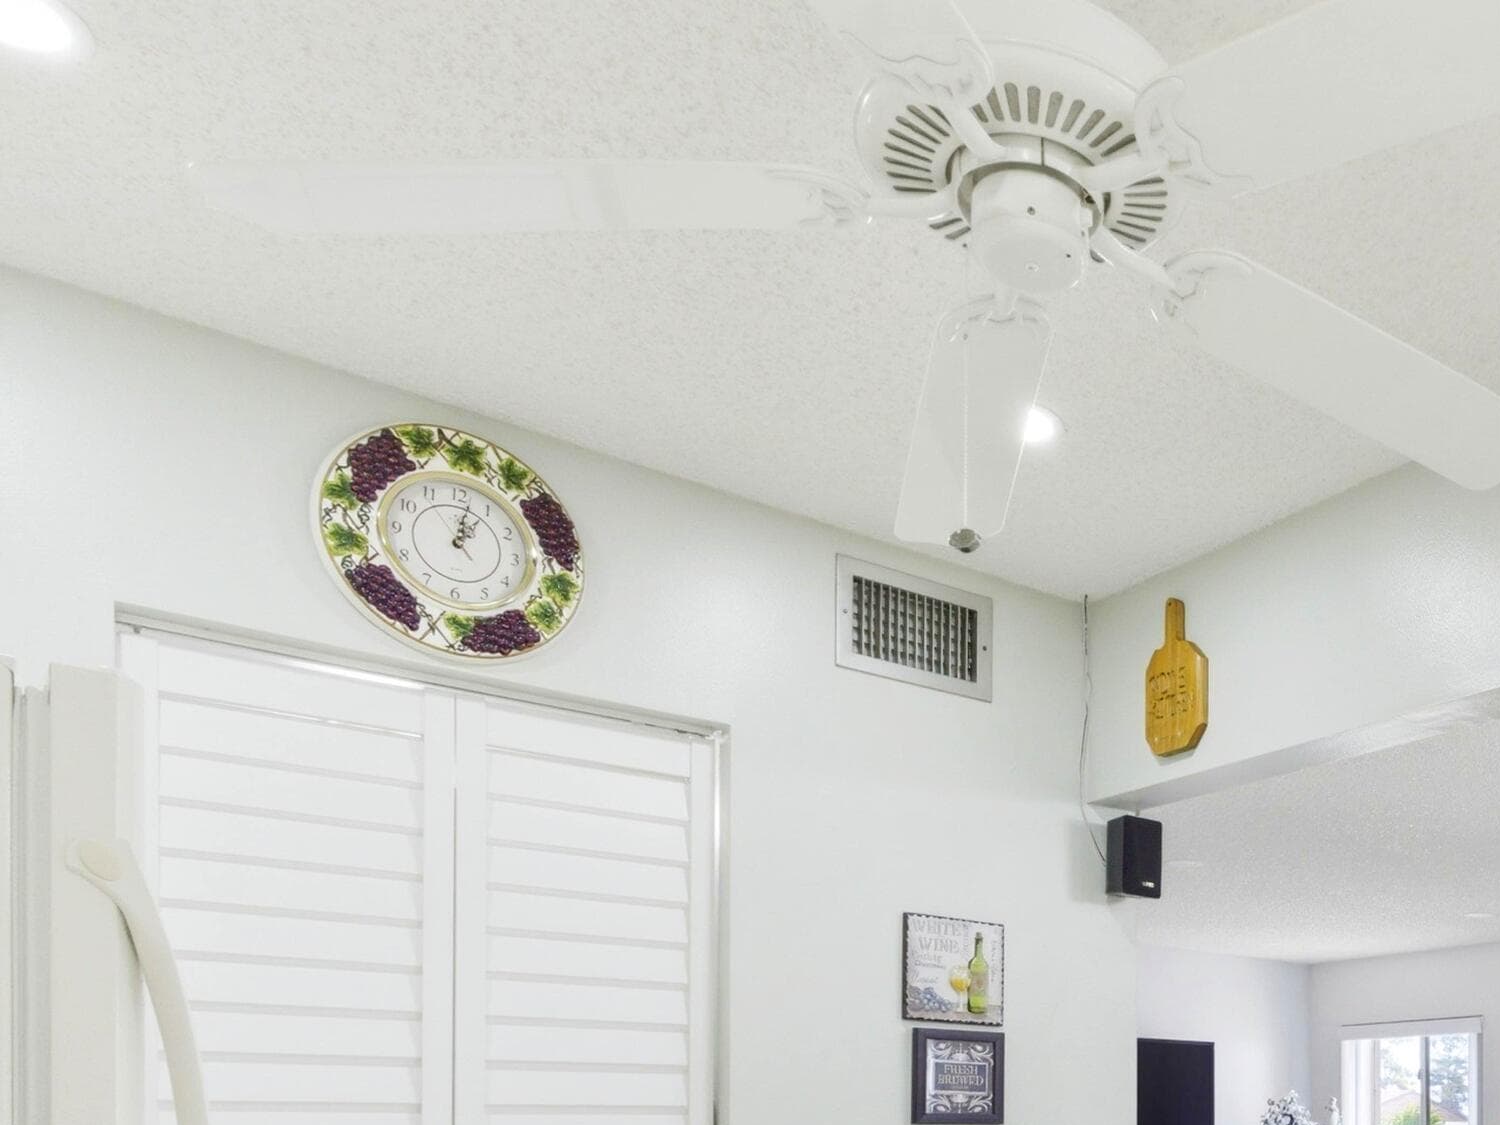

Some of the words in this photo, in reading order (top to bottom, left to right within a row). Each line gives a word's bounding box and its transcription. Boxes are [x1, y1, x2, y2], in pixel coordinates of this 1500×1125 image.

[423, 486, 436, 501] 11
[452, 487, 468, 503] 12
[400, 498, 417, 513] 10
[485, 504, 491, 517] 1
[391, 520, 402, 534] 9
[502, 527, 513, 541] 2
[399, 548, 410, 561] 8
[510, 553, 521, 567] 3
[422, 572, 432, 585] 7
[500, 576, 510, 588] 4
[450, 587, 461, 600] 6
[480, 587, 490, 600] 5
[911, 918, 962, 937] WHITE
[918, 936, 960, 954] WINE
[944, 1063, 978, 1075] FRESH
[937, 1074, 984, 1087] BREWED
